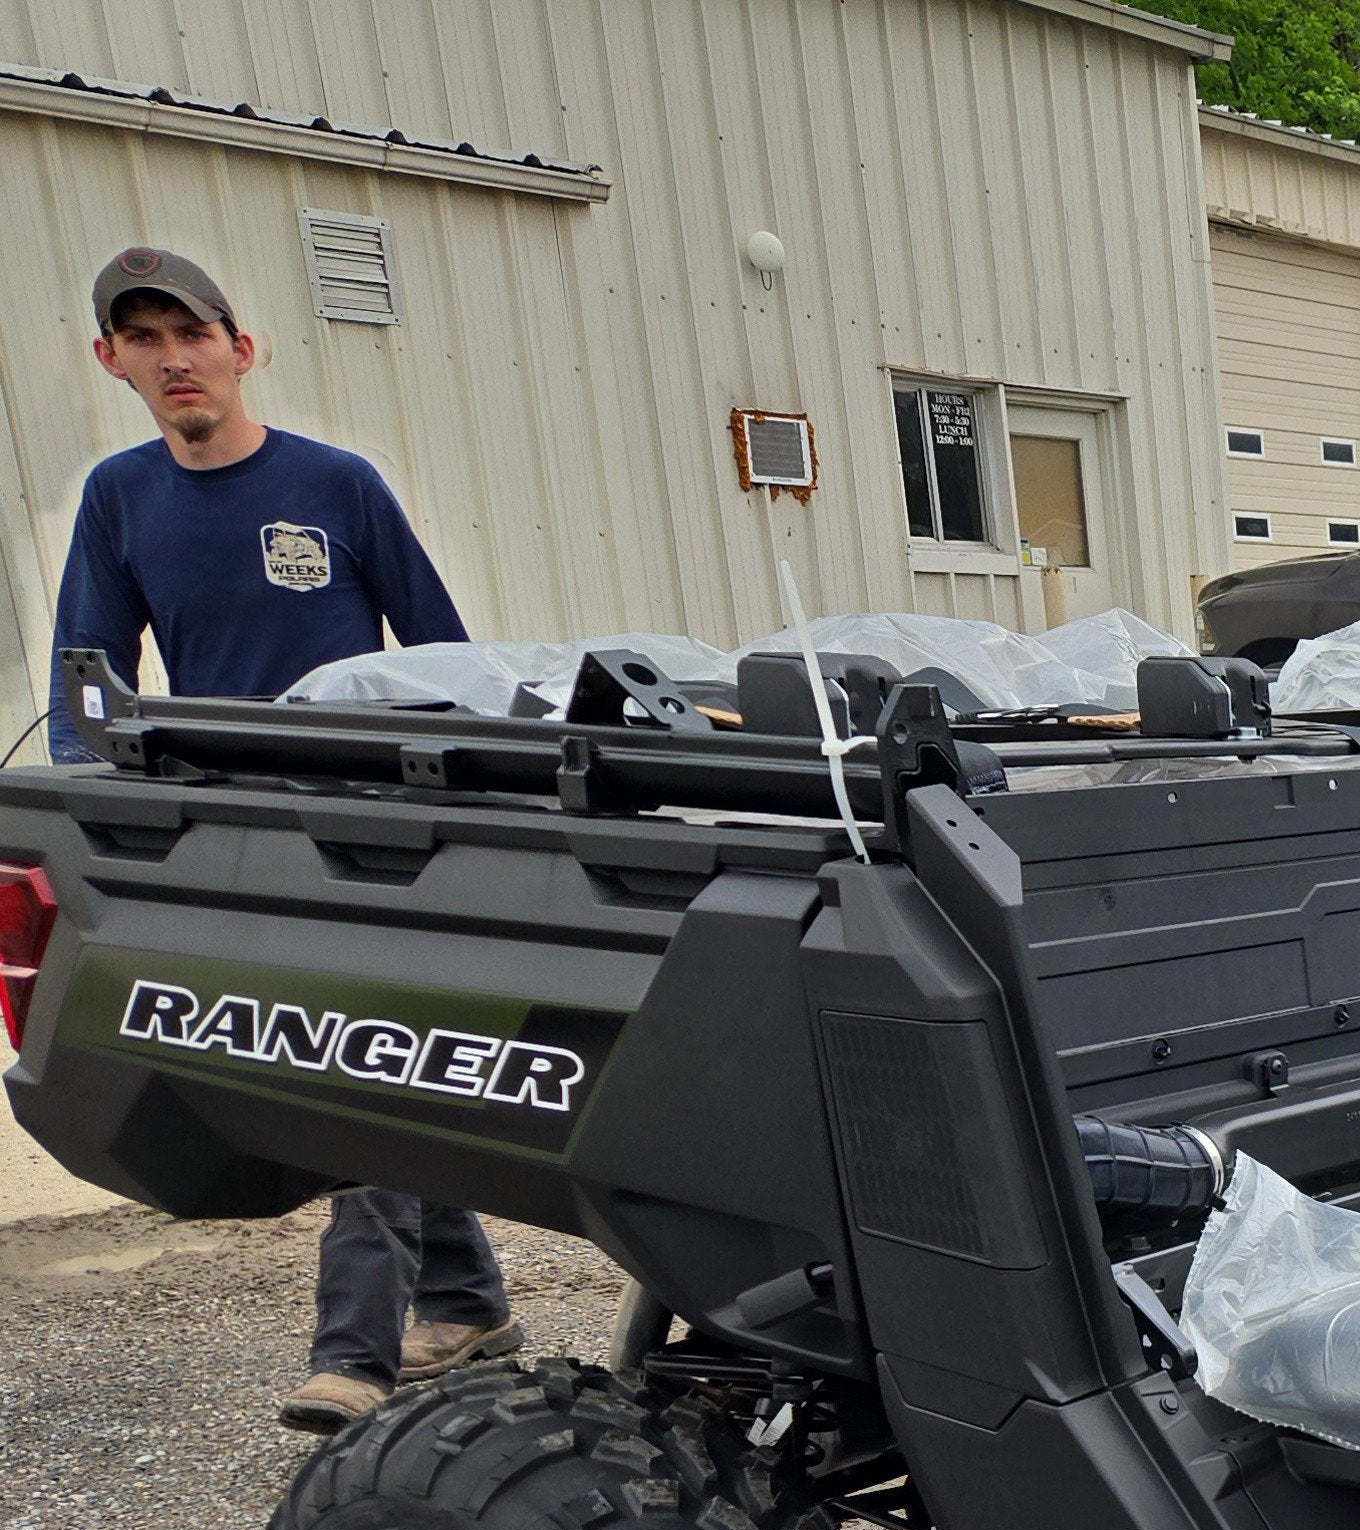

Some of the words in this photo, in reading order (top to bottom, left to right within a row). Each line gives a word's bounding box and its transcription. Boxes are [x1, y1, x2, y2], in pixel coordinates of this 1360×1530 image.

[935, 393, 965, 405] HOURS
[931, 403, 951, 414] MON
[956, 406, 970, 416] FRI
[938, 424, 968, 436] LUNCH
[269, 563, 328, 577] WEEKS
[119, 979, 586, 1112] RANGER
